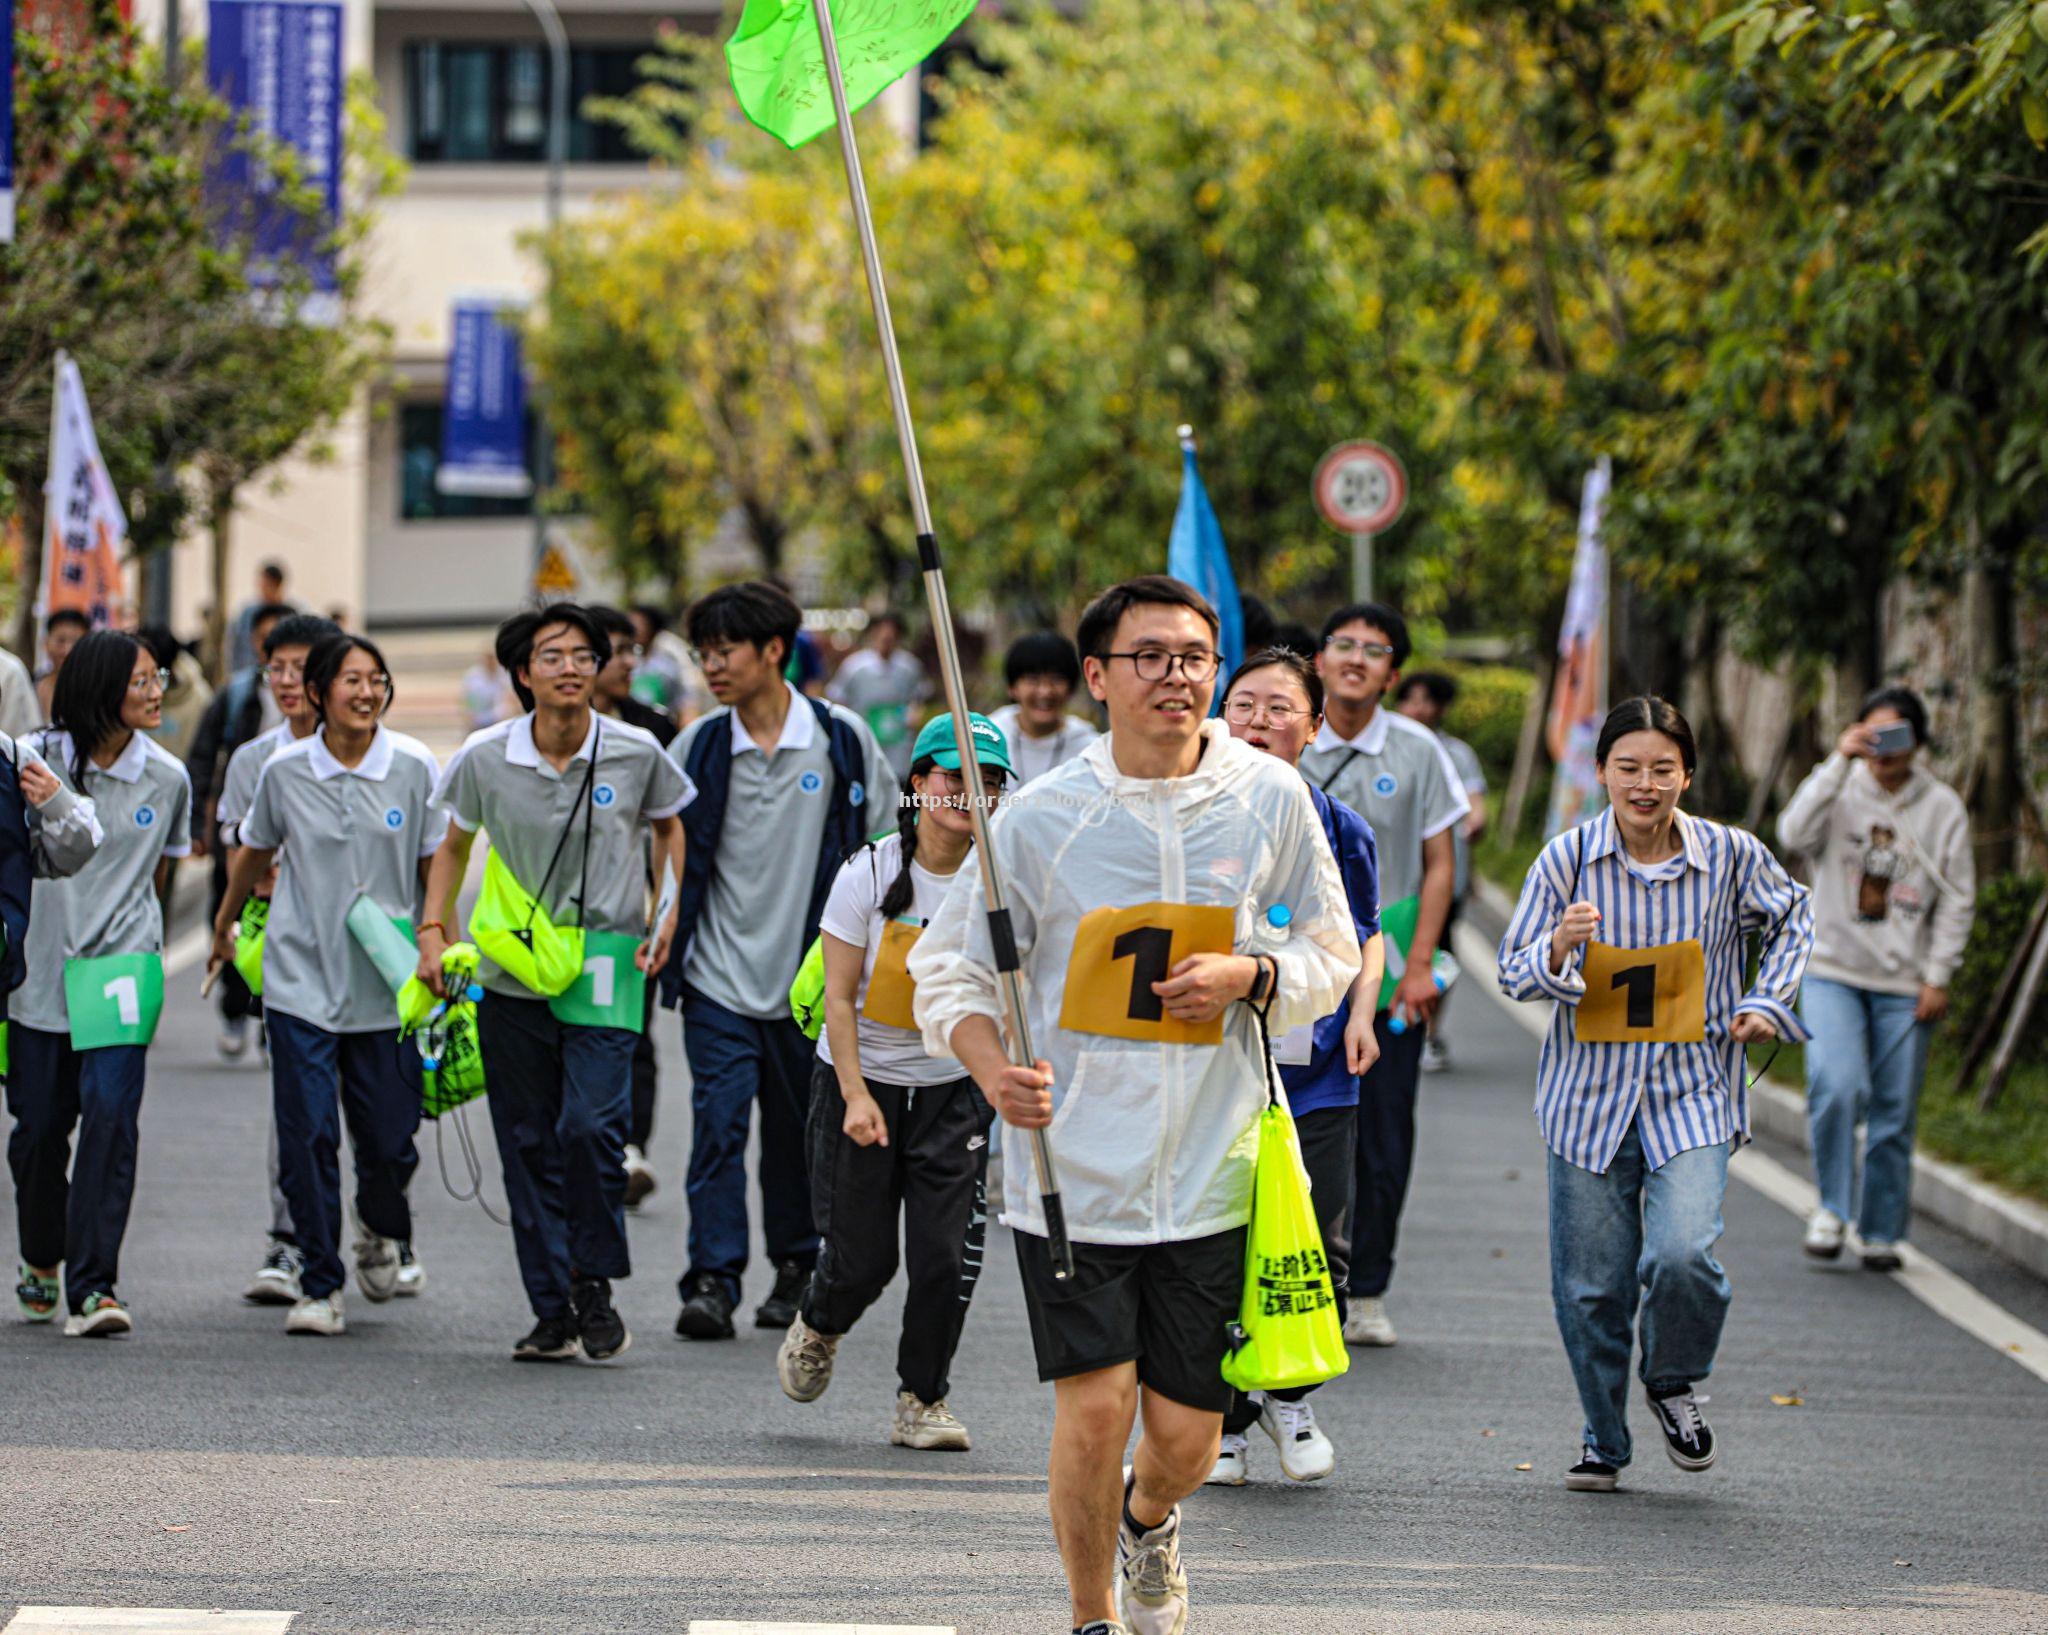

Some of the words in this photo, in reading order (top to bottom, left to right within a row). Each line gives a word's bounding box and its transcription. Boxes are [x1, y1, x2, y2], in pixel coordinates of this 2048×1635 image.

[103, 976, 140, 1025] 1
[583, 955, 615, 1006] 1
[1112, 926, 1174, 1022] 1
[1611, 964, 1656, 1028] 1
